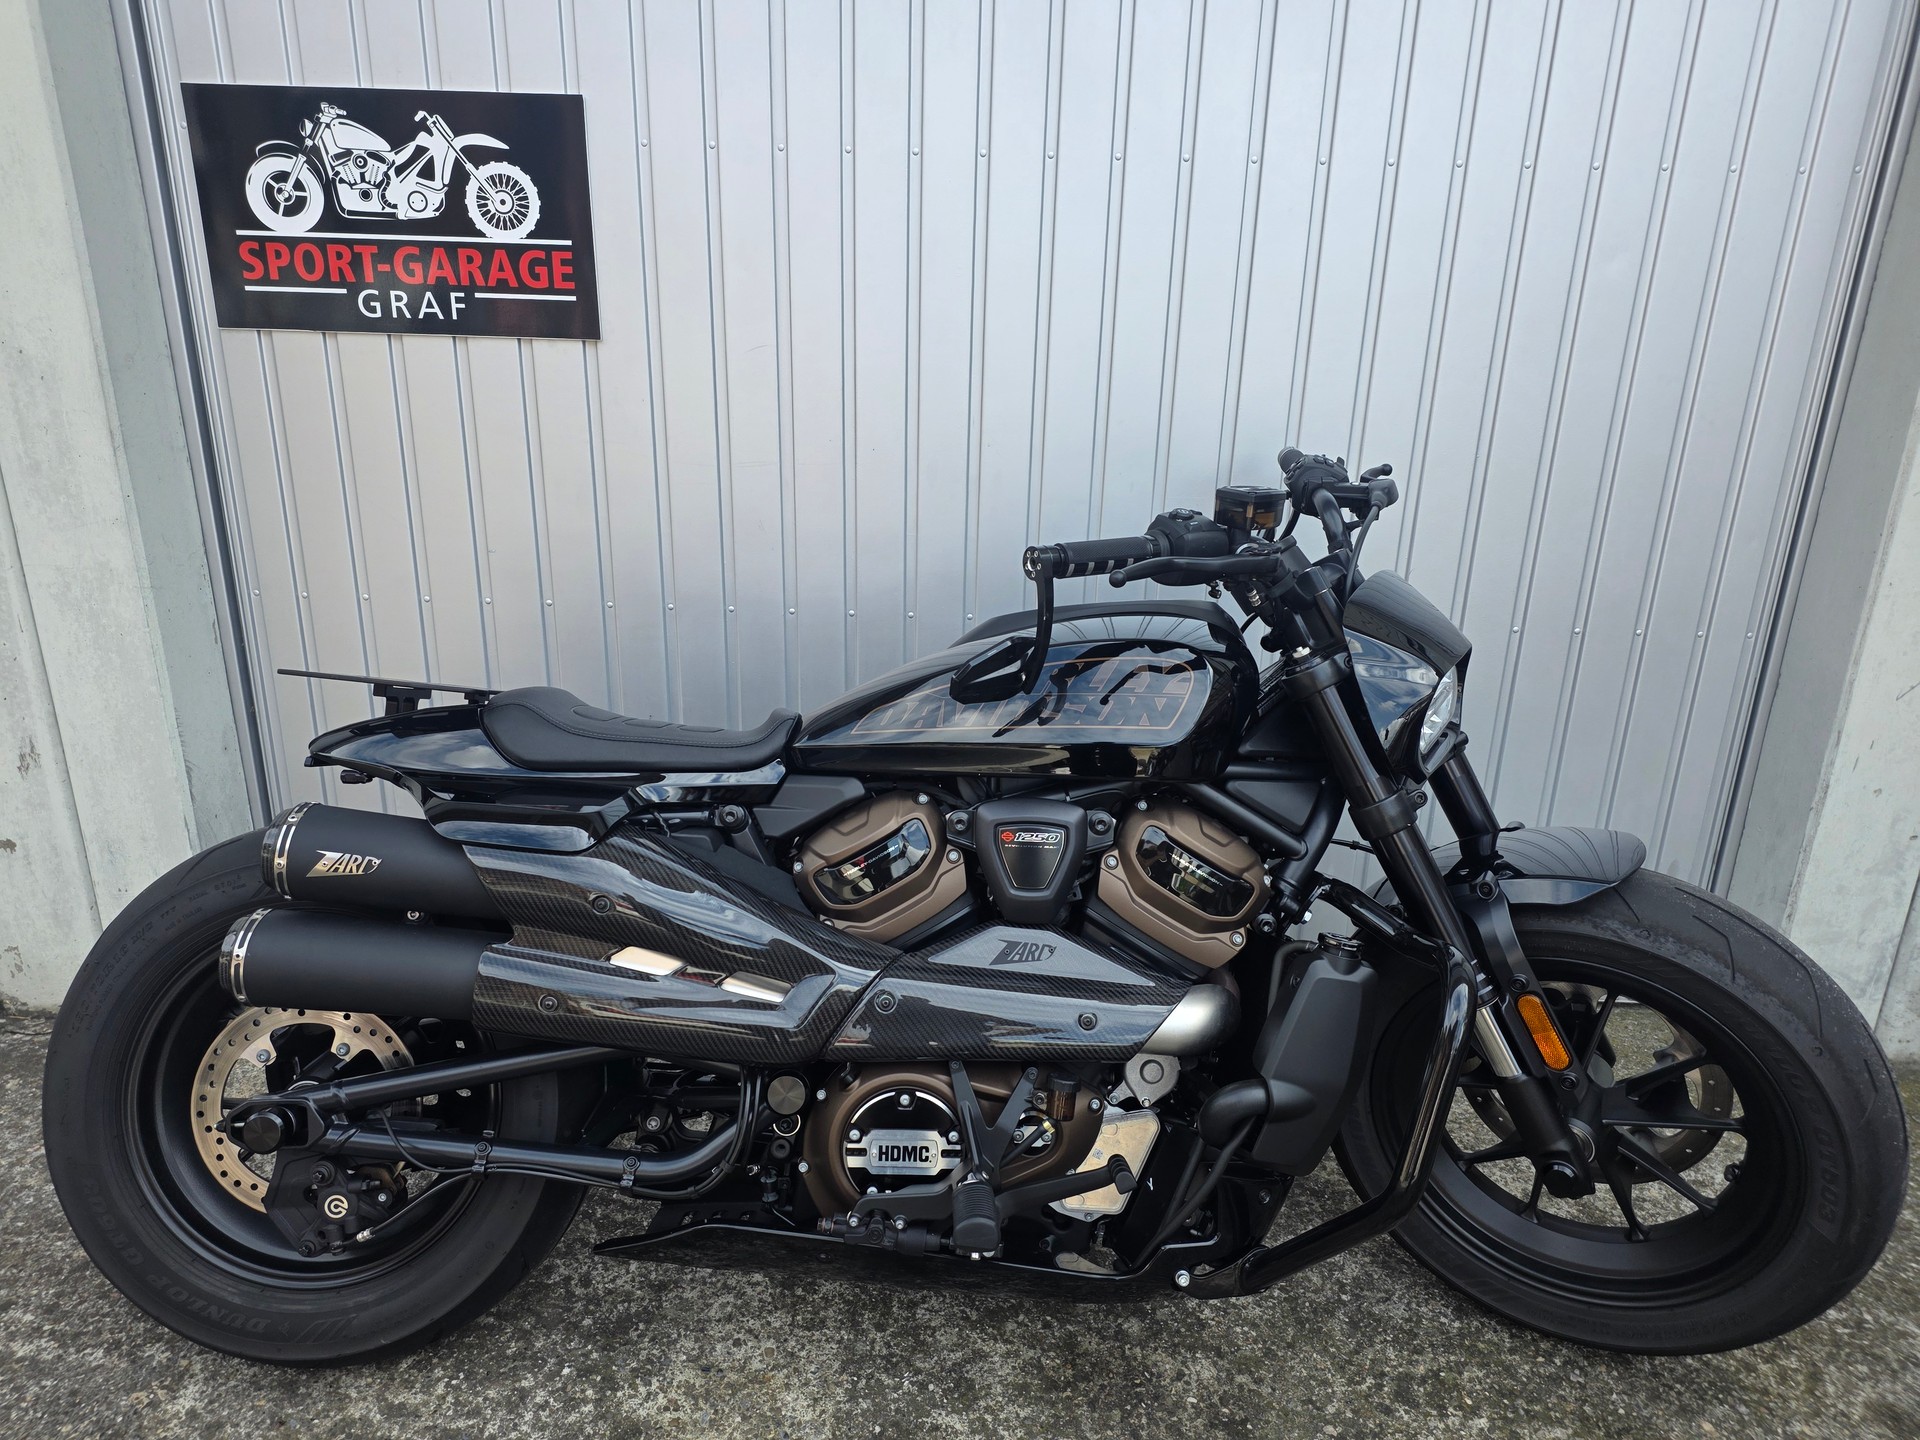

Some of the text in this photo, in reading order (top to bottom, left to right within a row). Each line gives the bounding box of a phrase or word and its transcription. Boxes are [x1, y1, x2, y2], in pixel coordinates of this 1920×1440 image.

[238, 241, 576, 289] SPORT-GARAGE
[358, 289, 466, 320] GRAF
[1014, 832, 1060, 843] 1250
[306, 850, 382, 877] ZARD
[989, 939, 1057, 965] ZARD
